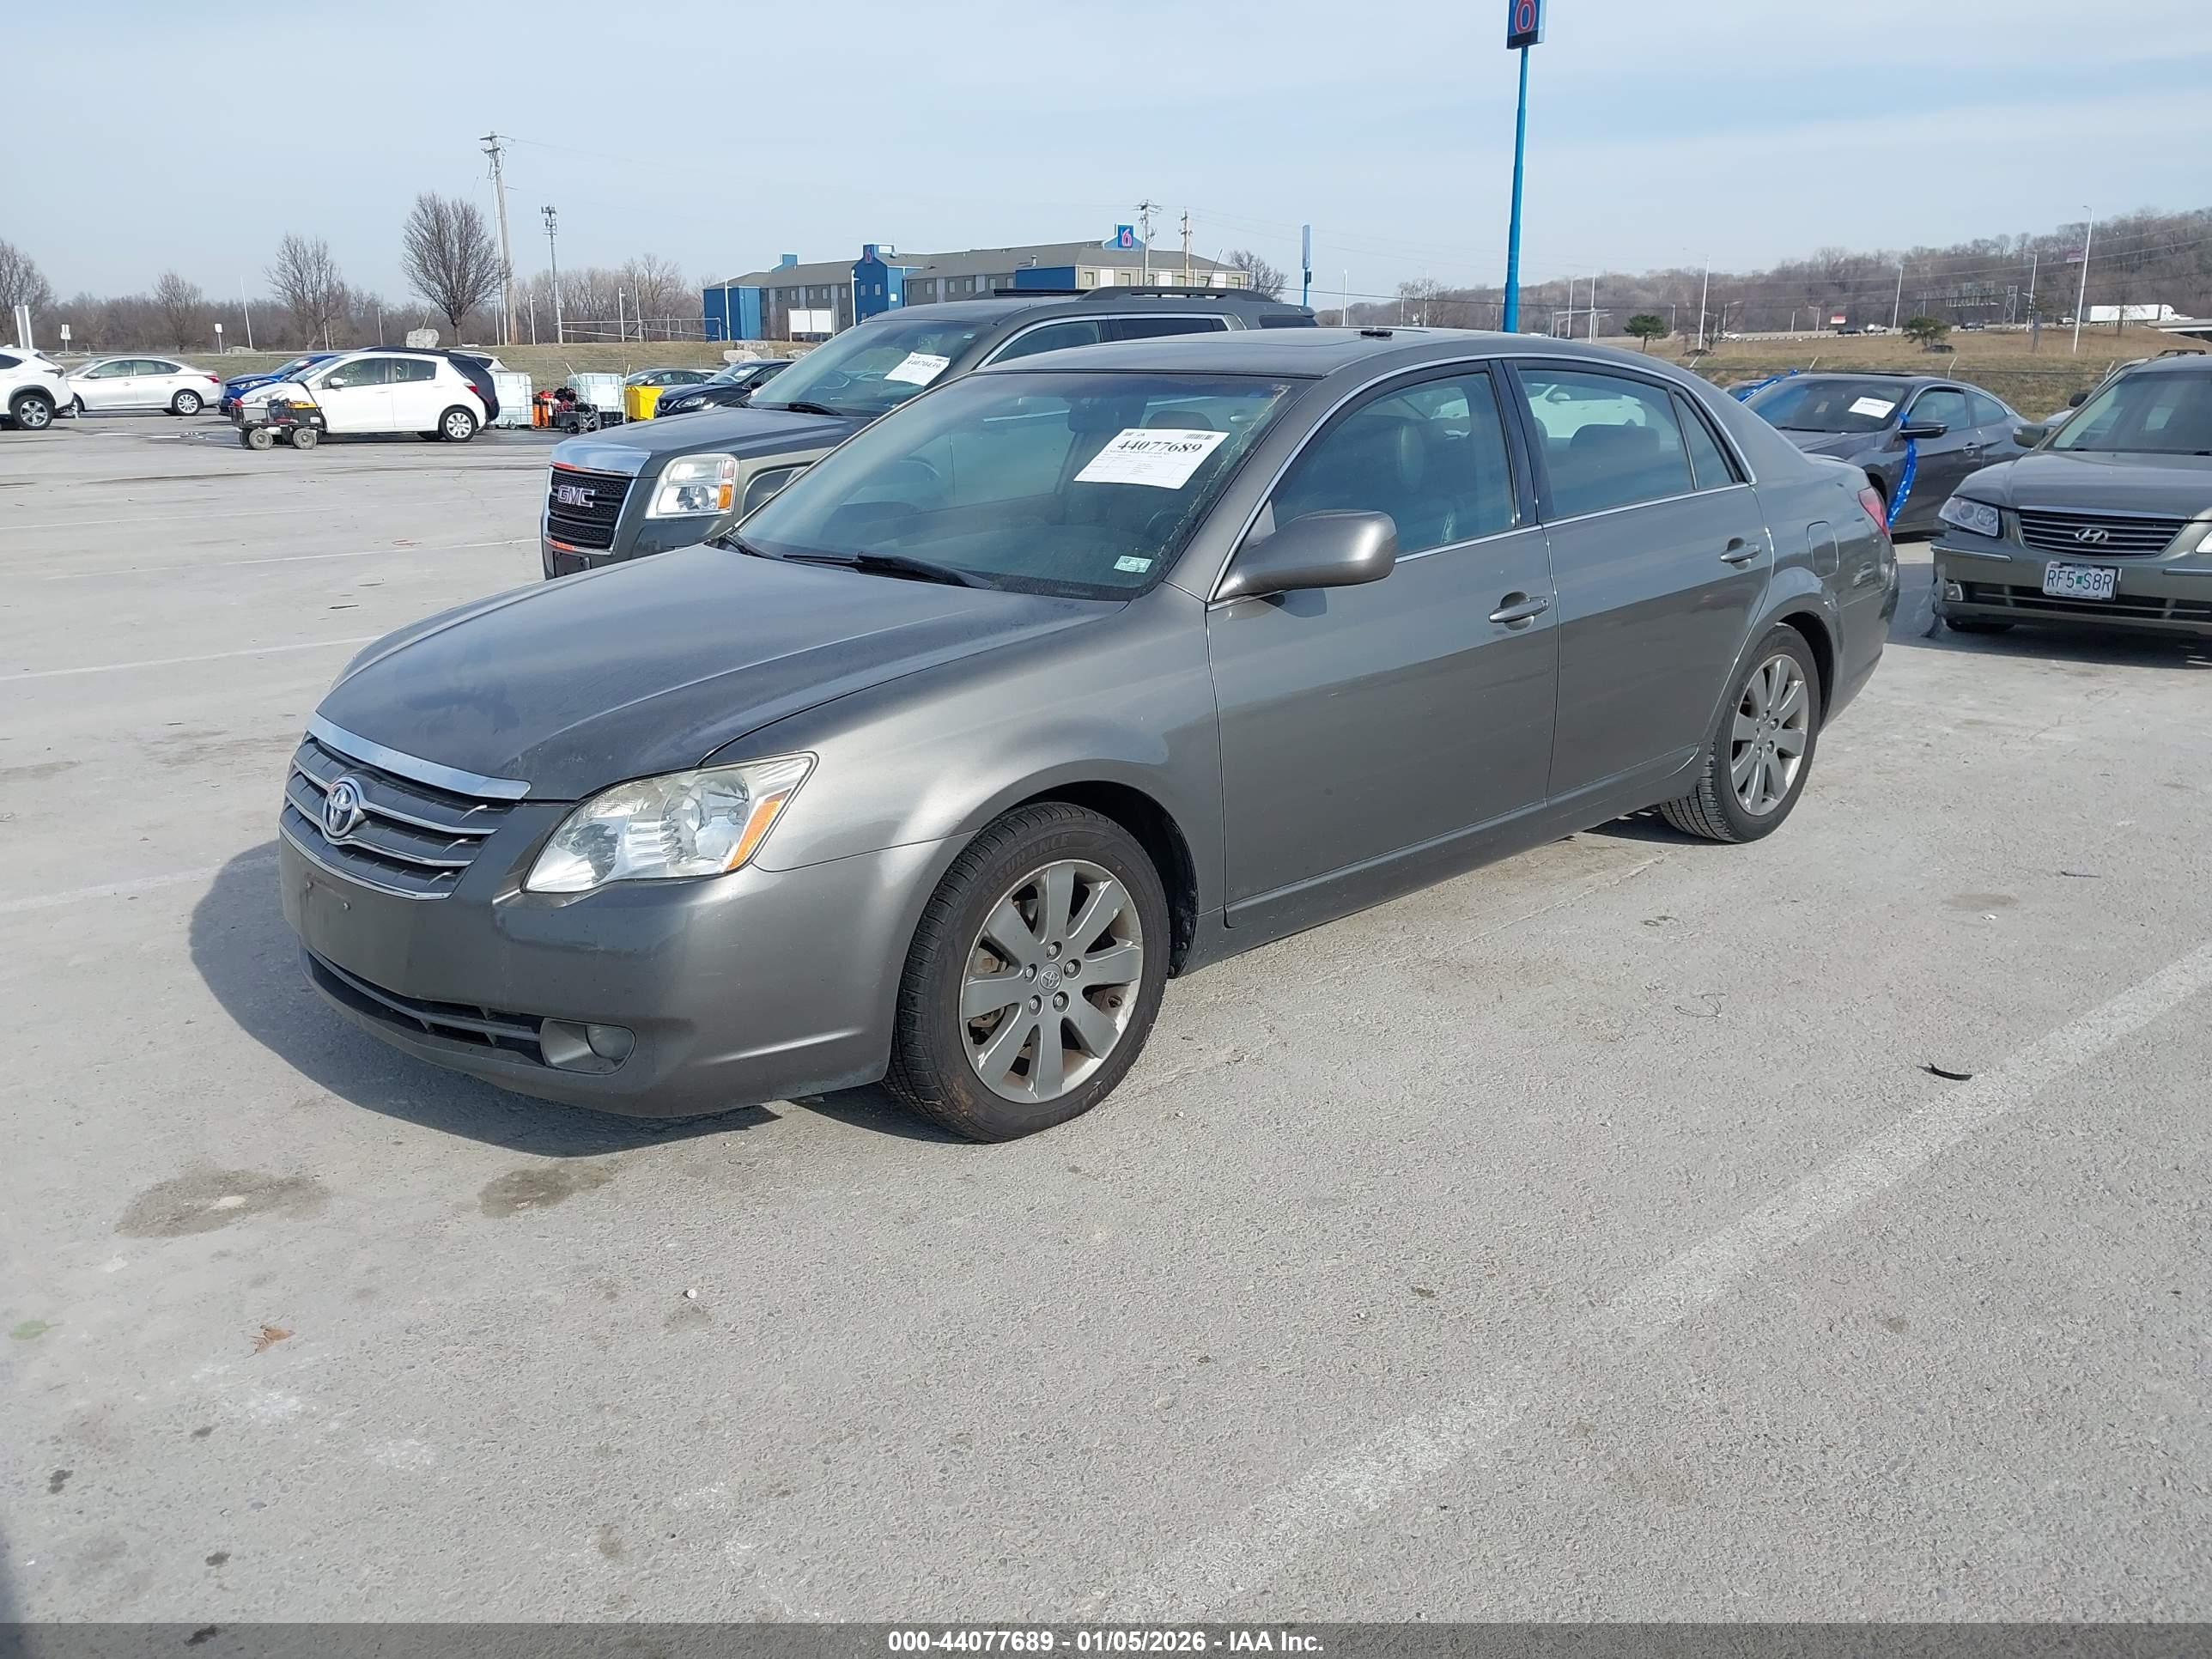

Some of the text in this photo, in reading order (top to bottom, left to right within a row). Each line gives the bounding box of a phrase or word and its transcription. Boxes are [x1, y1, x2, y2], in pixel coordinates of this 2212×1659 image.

[1121, 228, 1133, 247] 6
[1117, 440, 1203, 453] 44077689
[557, 485, 595, 508] GMC
[2046, 569, 2112, 592] RF5 S8R
